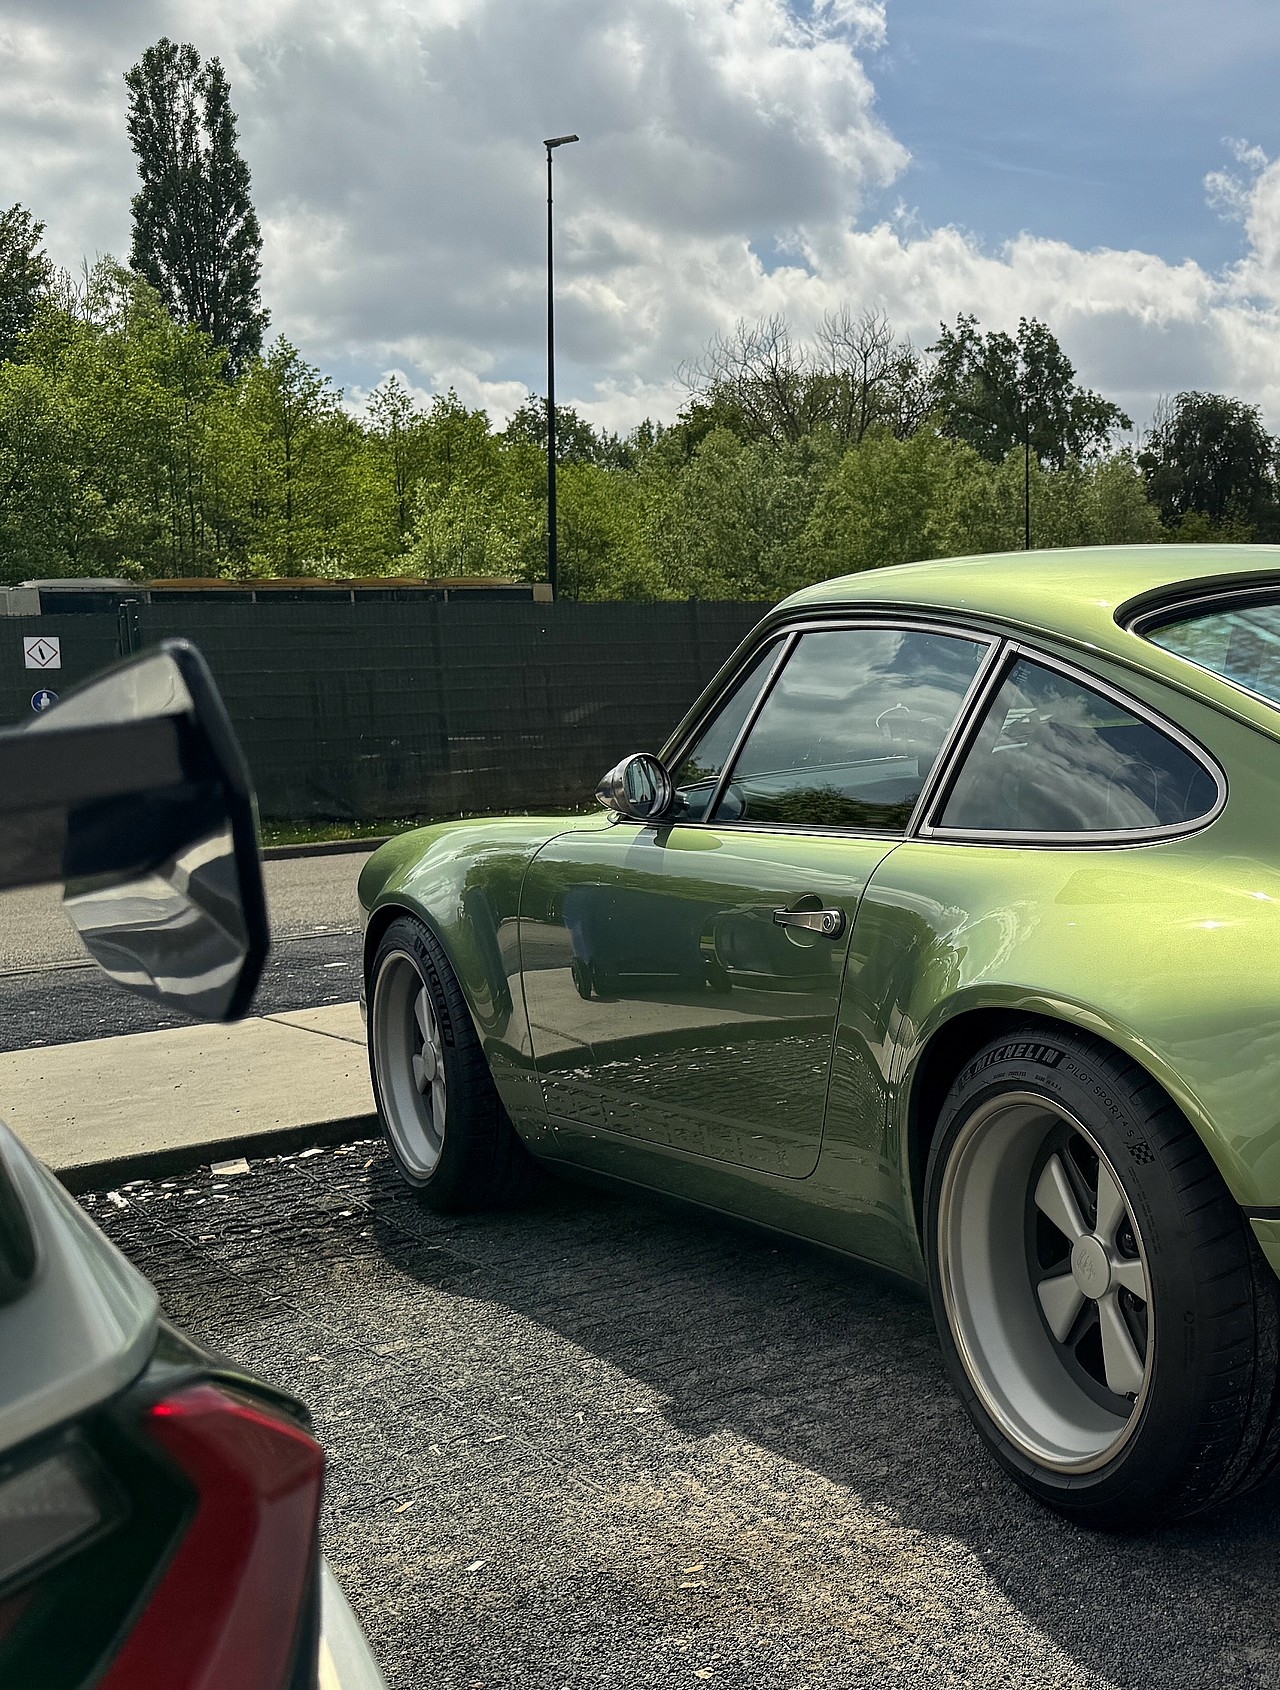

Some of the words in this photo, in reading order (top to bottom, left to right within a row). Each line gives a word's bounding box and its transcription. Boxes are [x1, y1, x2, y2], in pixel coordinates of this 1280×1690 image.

[974, 1044, 1059, 1074] MICHELIN
[1065, 1062, 1095, 1086] PILOT
[1093, 1085, 1125, 1120] SPORT
[1126, 1129, 1135, 1138] S
